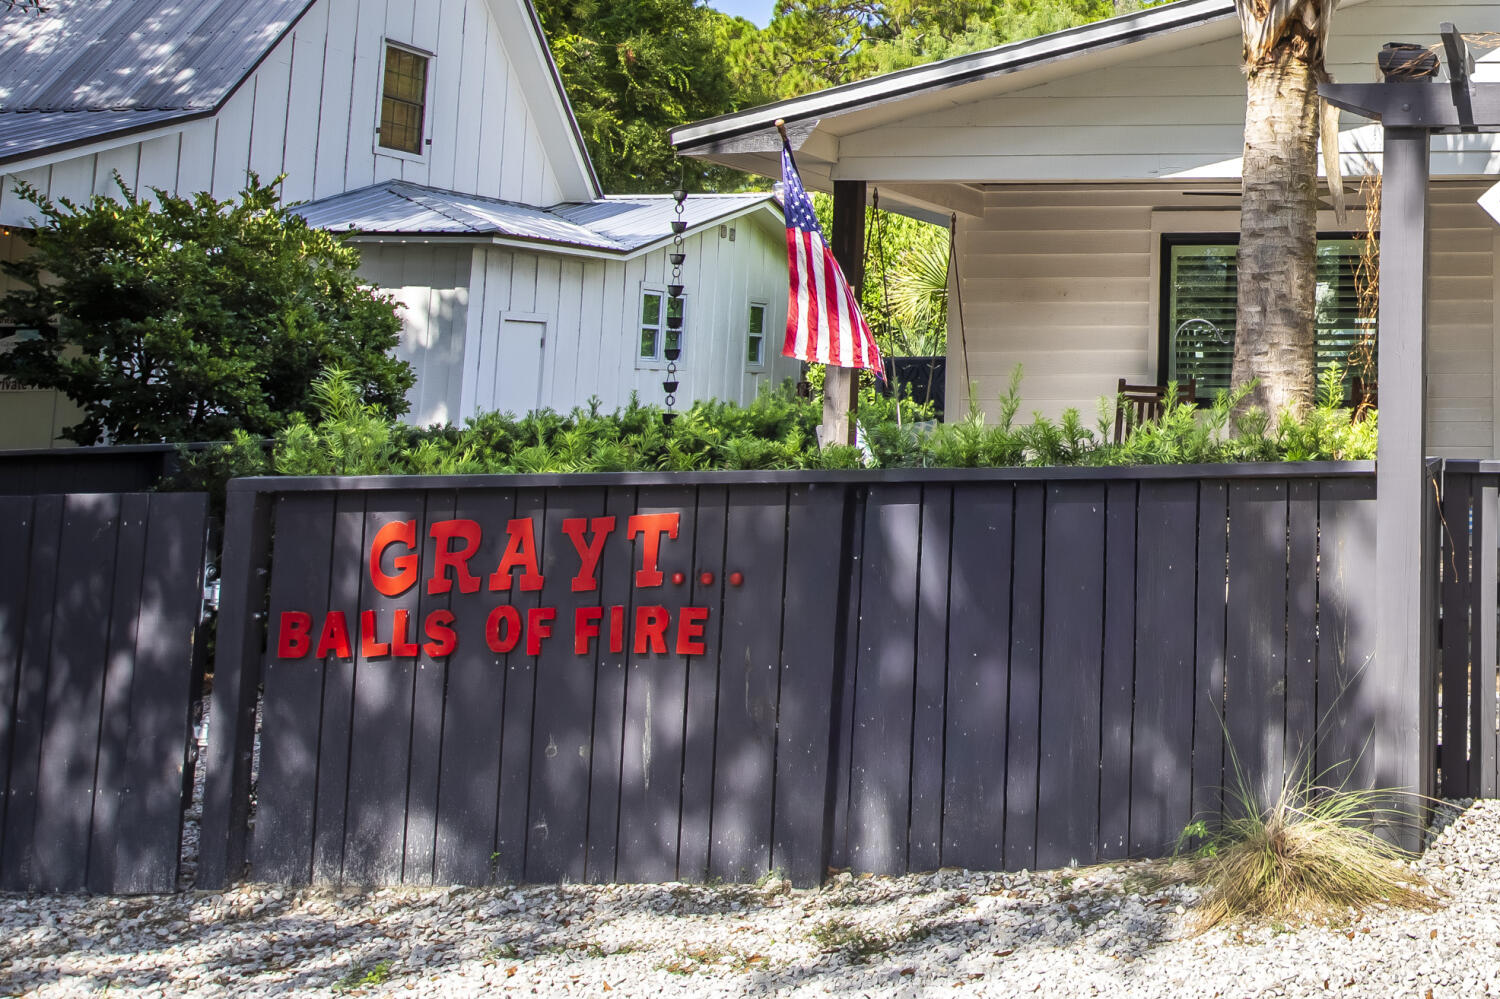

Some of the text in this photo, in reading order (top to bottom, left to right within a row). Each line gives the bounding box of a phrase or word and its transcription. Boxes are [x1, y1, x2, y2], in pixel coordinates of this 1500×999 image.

[369, 513, 743, 597] GRAYT...
[277, 604, 708, 659] BALLS OF FIRE
